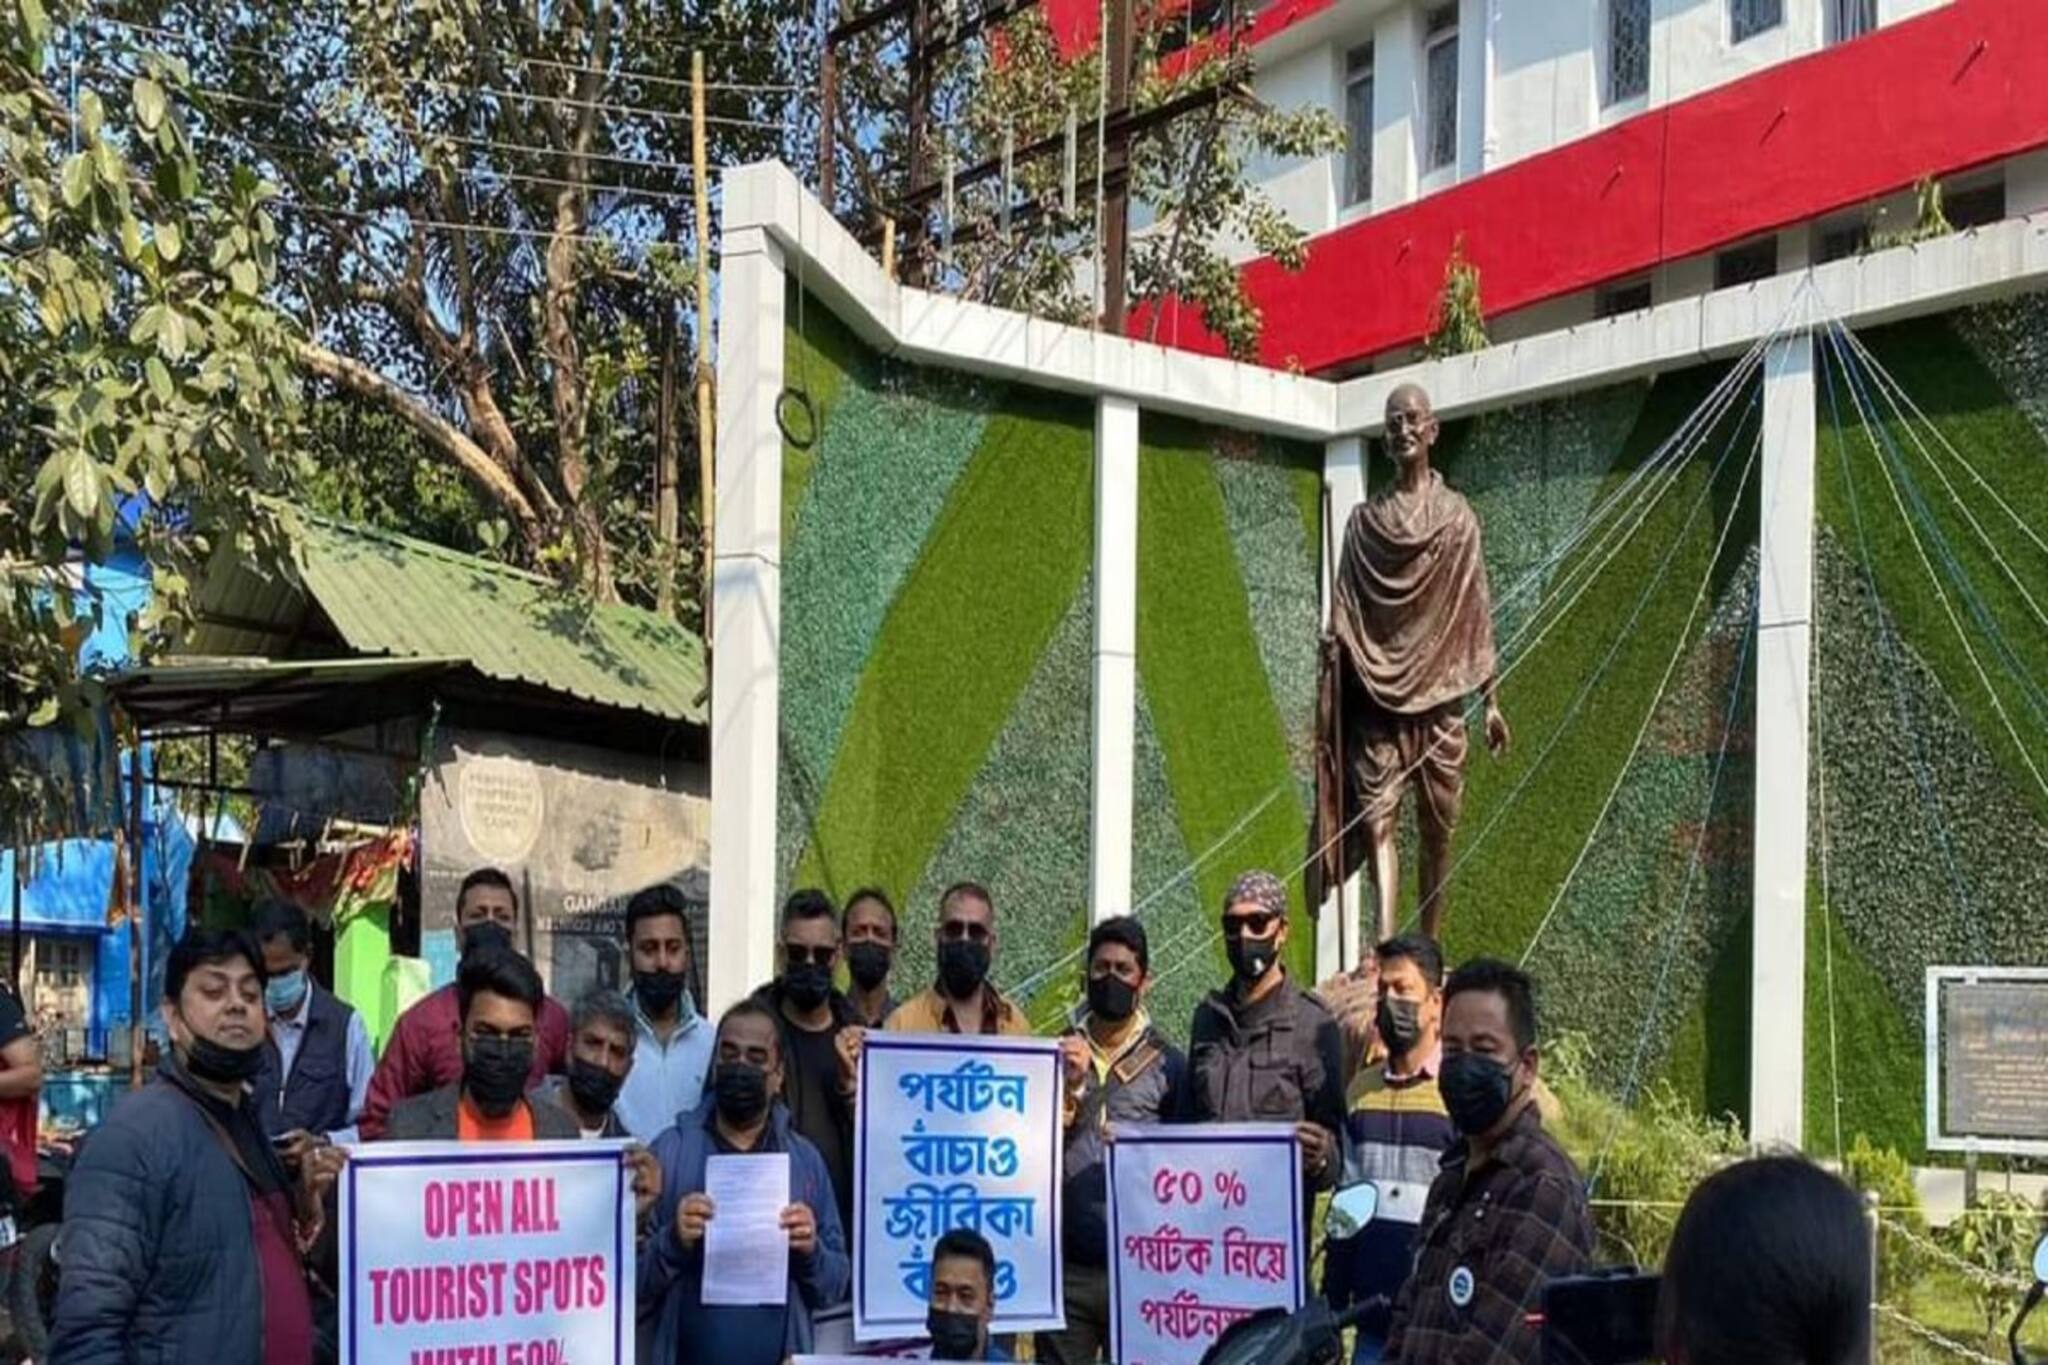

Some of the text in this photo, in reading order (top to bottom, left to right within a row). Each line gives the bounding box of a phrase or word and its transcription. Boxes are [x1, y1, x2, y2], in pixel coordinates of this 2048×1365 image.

[898, 1058, 1028, 1114] পর্যটন
[900, 1118, 1018, 1177] বাঁচাও
[424, 1177, 560, 1239] OPEN ALL
[881, 1182, 1036, 1242] জীবিকা
[1153, 1168, 1247, 1210] ৫০ %
[1125, 1223, 1288, 1284] পর্যটক নিয়ে
[368, 1255, 606, 1326] TOURIST SPOTS
